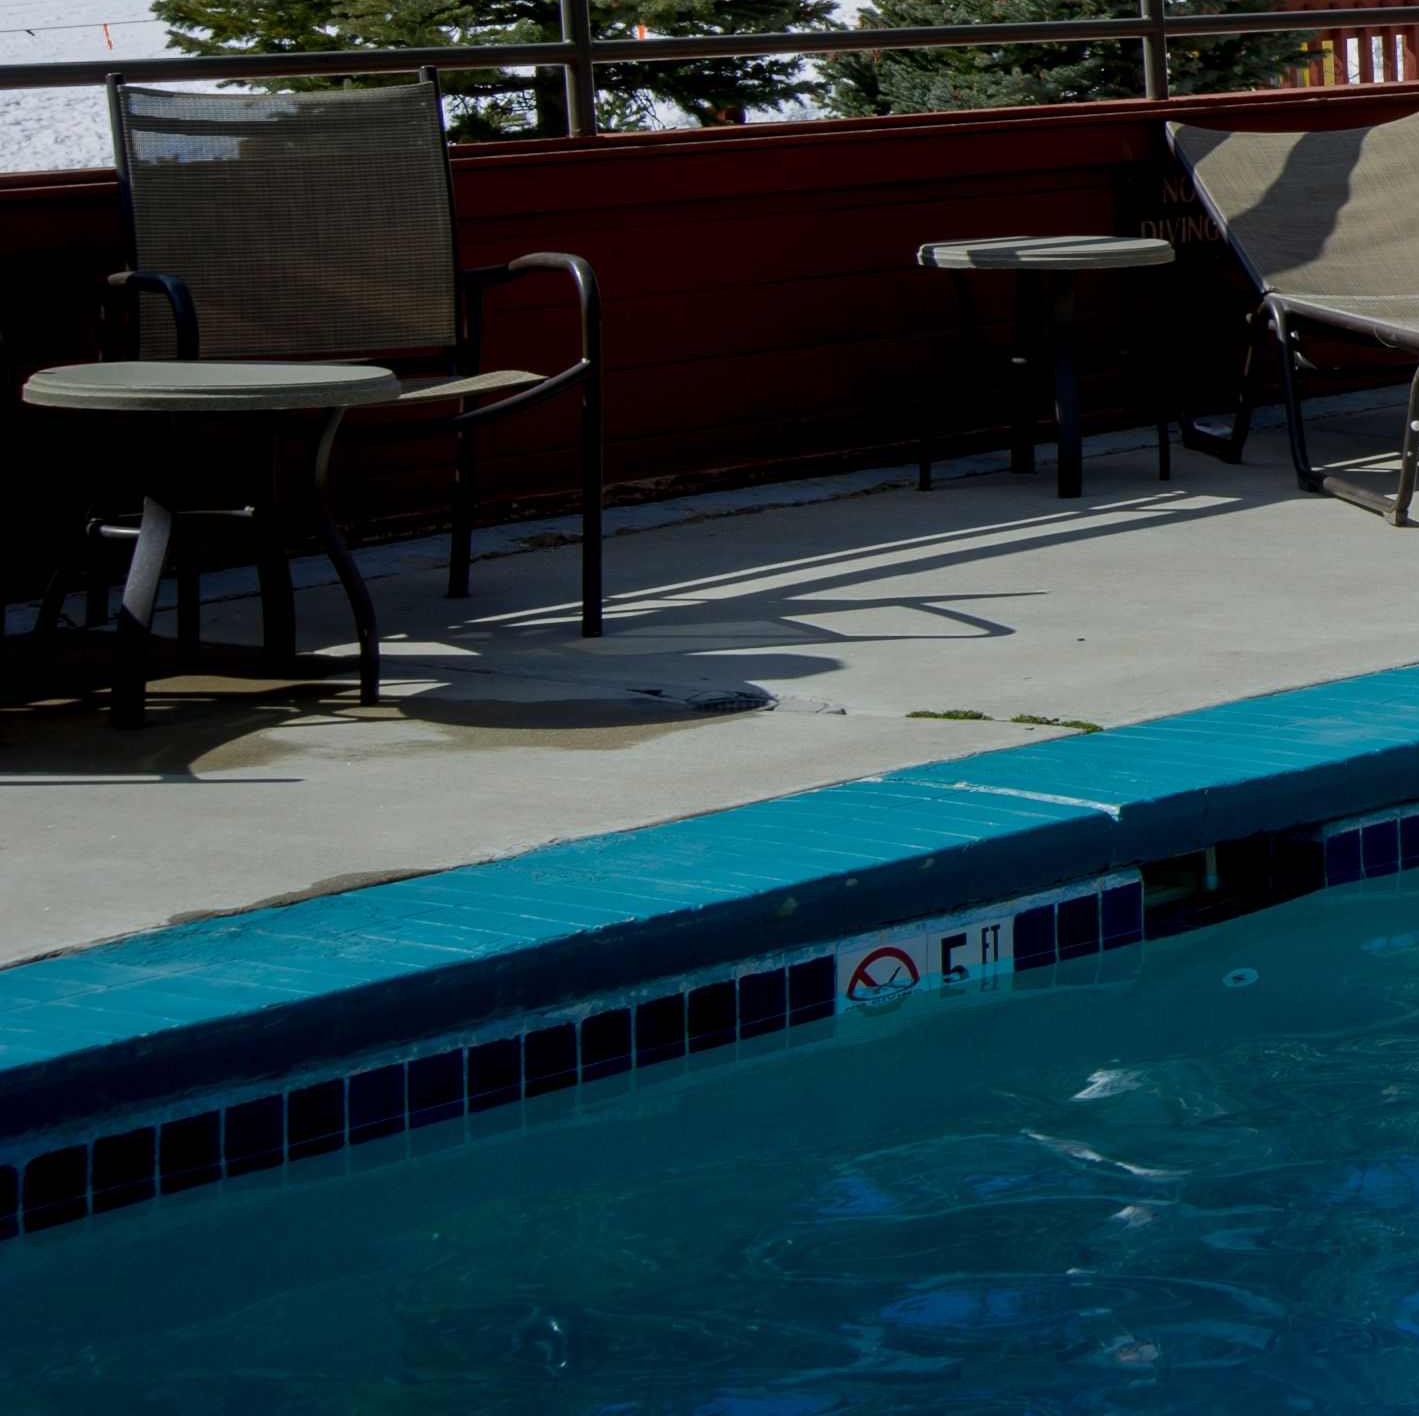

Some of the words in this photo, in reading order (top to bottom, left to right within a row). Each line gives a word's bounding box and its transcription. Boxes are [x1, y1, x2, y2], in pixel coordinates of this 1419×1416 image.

[1163, 177, 1197, 204] NO
[1141, 215, 1220, 244] DIVING
[942, 932, 969, 983] 5
[981, 924, 1001, 965] FT
